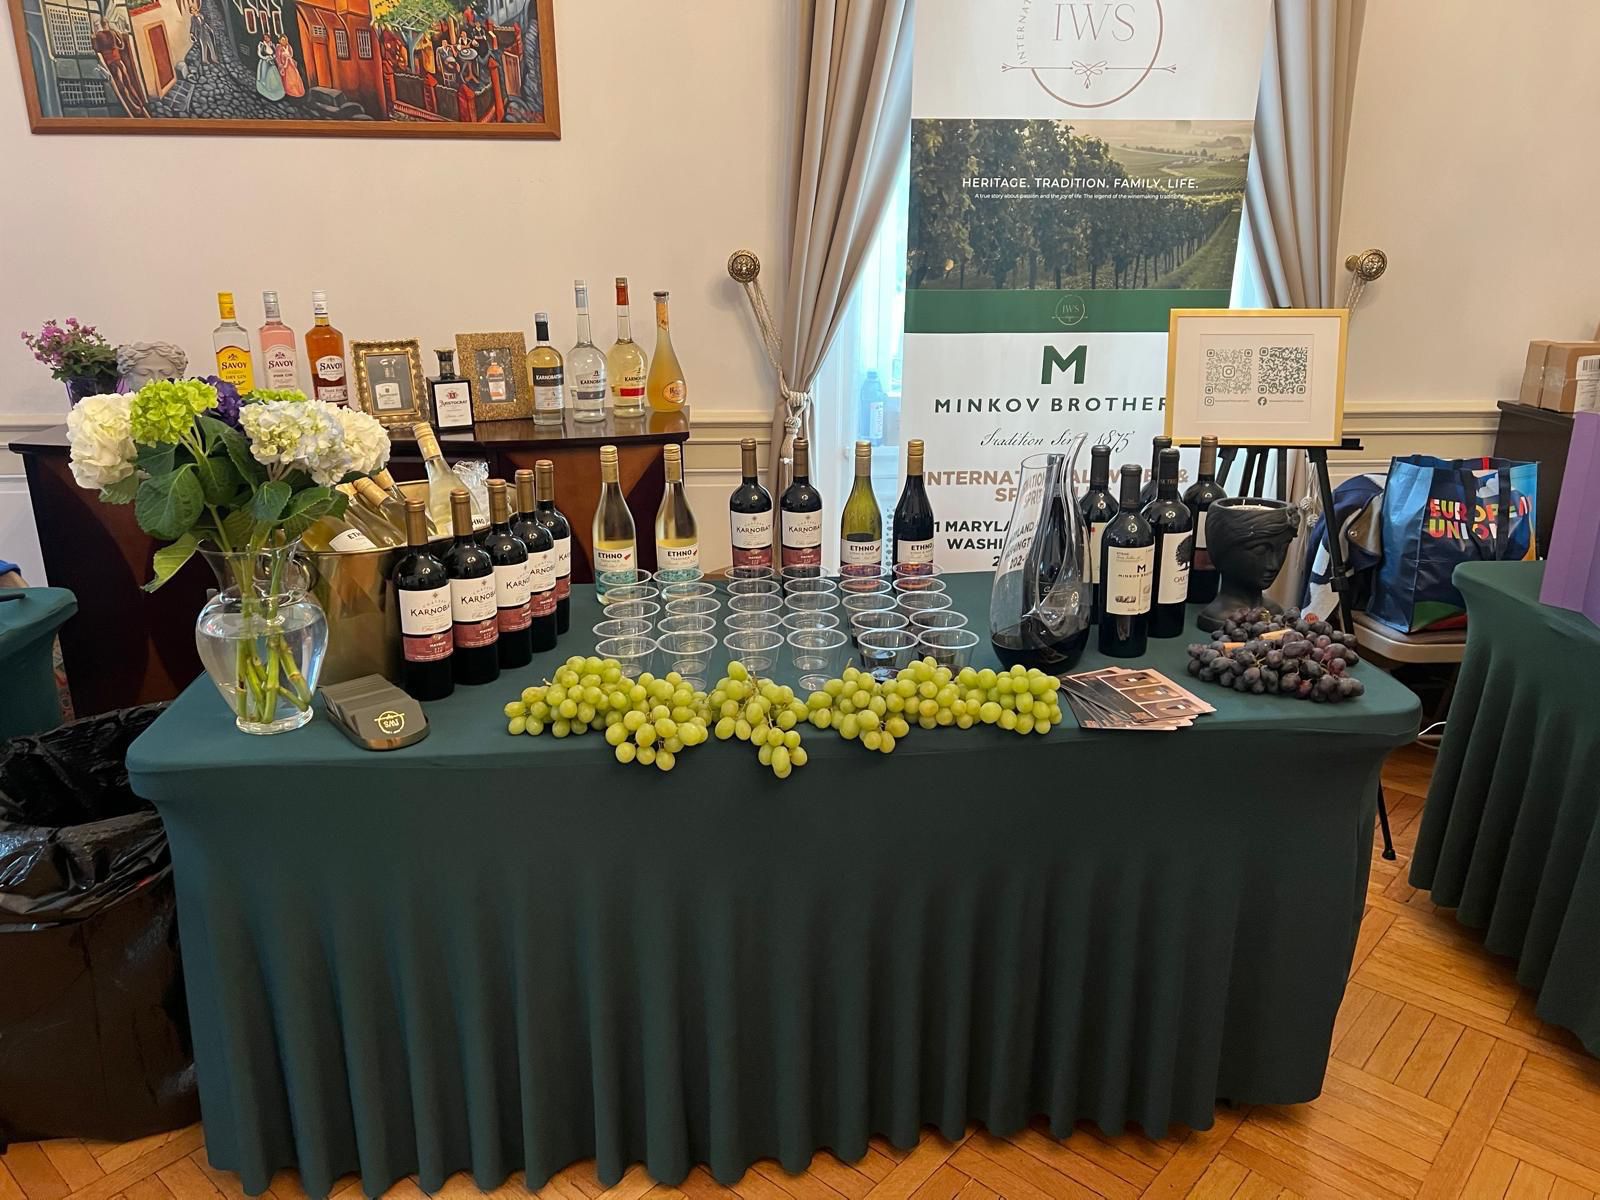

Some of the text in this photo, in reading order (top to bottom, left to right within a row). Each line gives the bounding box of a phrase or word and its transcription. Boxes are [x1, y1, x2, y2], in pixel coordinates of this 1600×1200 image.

[1053, 3, 1136, 42] IWS
[962, 177, 1199, 189] HERITAGE. TRADITION. FAMILY. LIFE.
[221, 362, 248, 370] SAVOY
[268, 360, 294, 370] SAVOY
[319, 362, 343, 371] SAVOY
[1041, 345, 1088, 385] M
[934, 398, 1041, 414] MINKOV
[980, 427, 1044, 447] Tradition
[911, 543, 933, 551] ETHNO
[667, 549, 692, 557] ETHNO
